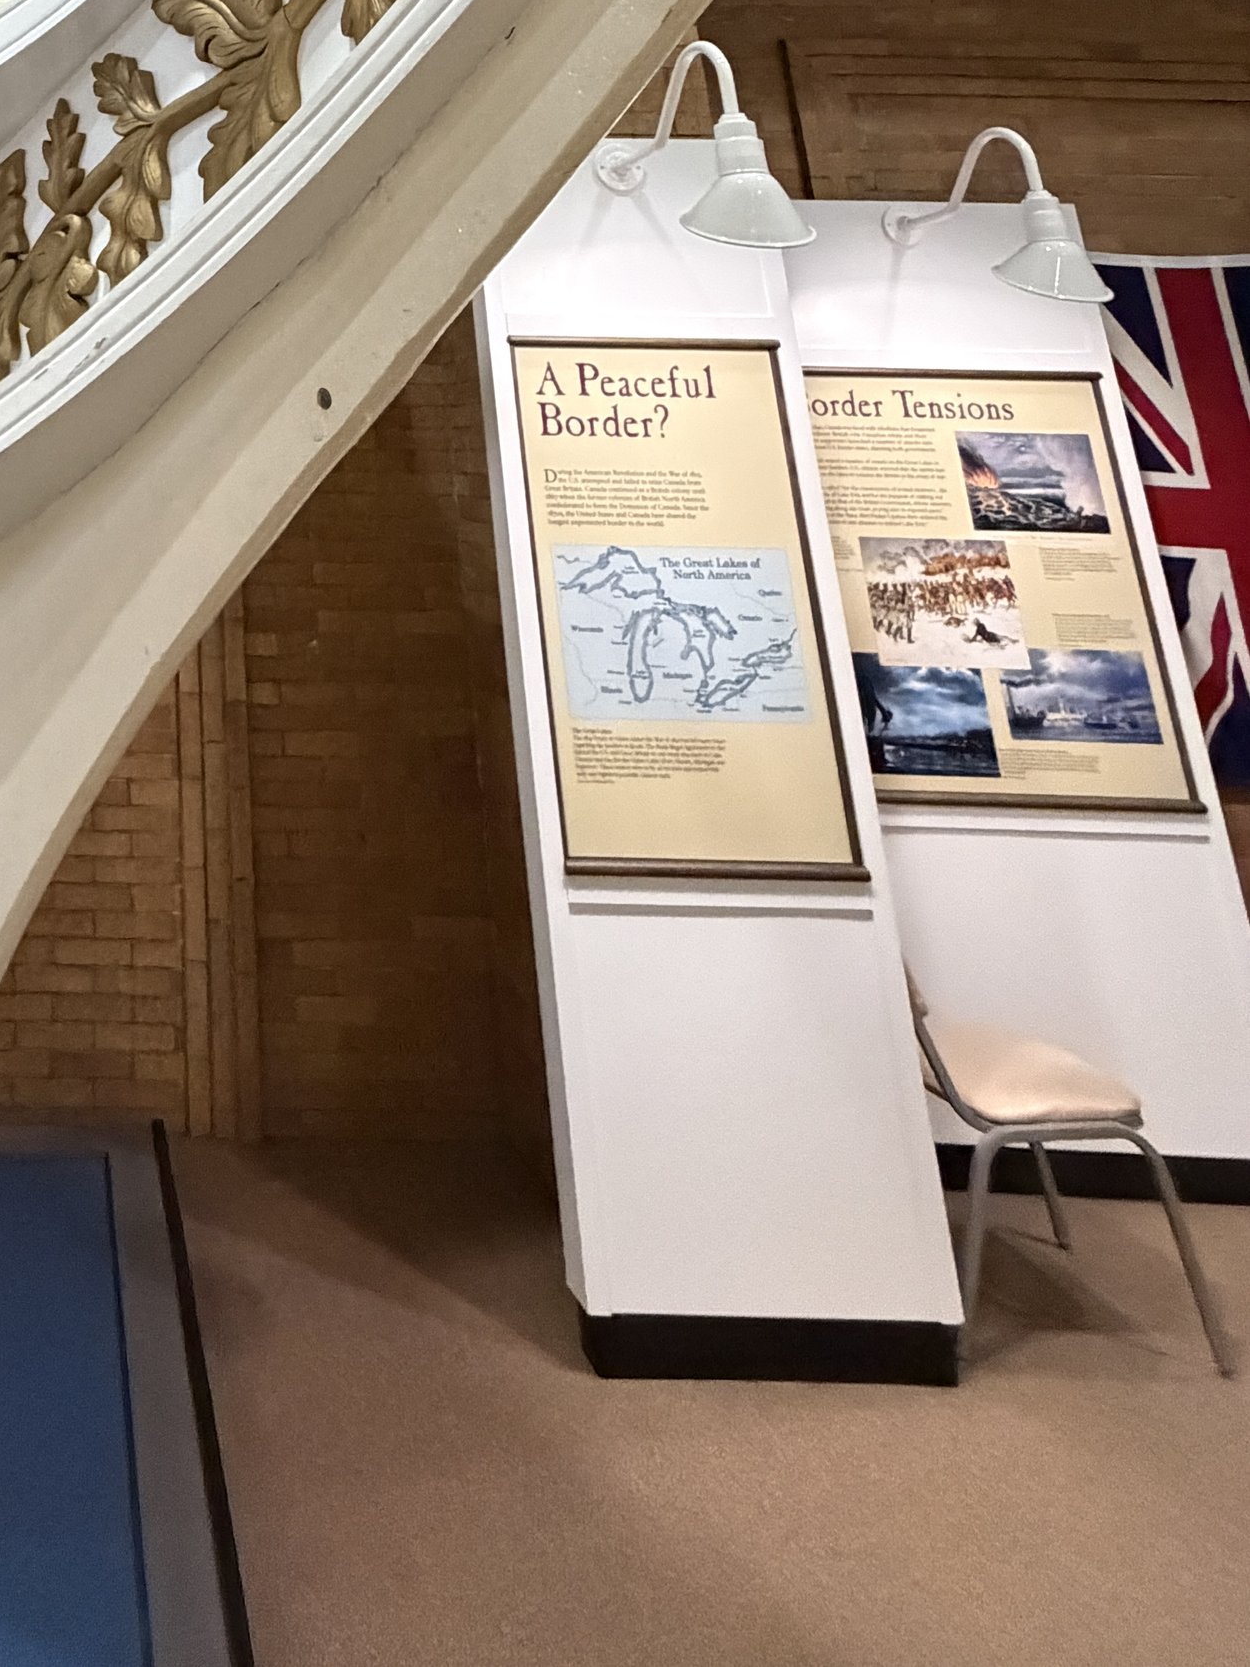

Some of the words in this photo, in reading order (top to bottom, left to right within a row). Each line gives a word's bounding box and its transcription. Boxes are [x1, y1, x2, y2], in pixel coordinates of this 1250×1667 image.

[536, 361, 565, 396] A
[575, 362, 716, 399] Peaceful
[537, 401, 669, 438] Border?
[806, 390, 883, 417] order
[892, 390, 1014, 421] Tensions
[659, 557, 681, 568] The
[683, 558, 713, 568] Great
[716, 558, 748, 568] Lakes
[750, 558, 761, 568] of
[673, 570, 704, 580] North
[707, 570, 751, 580] America
